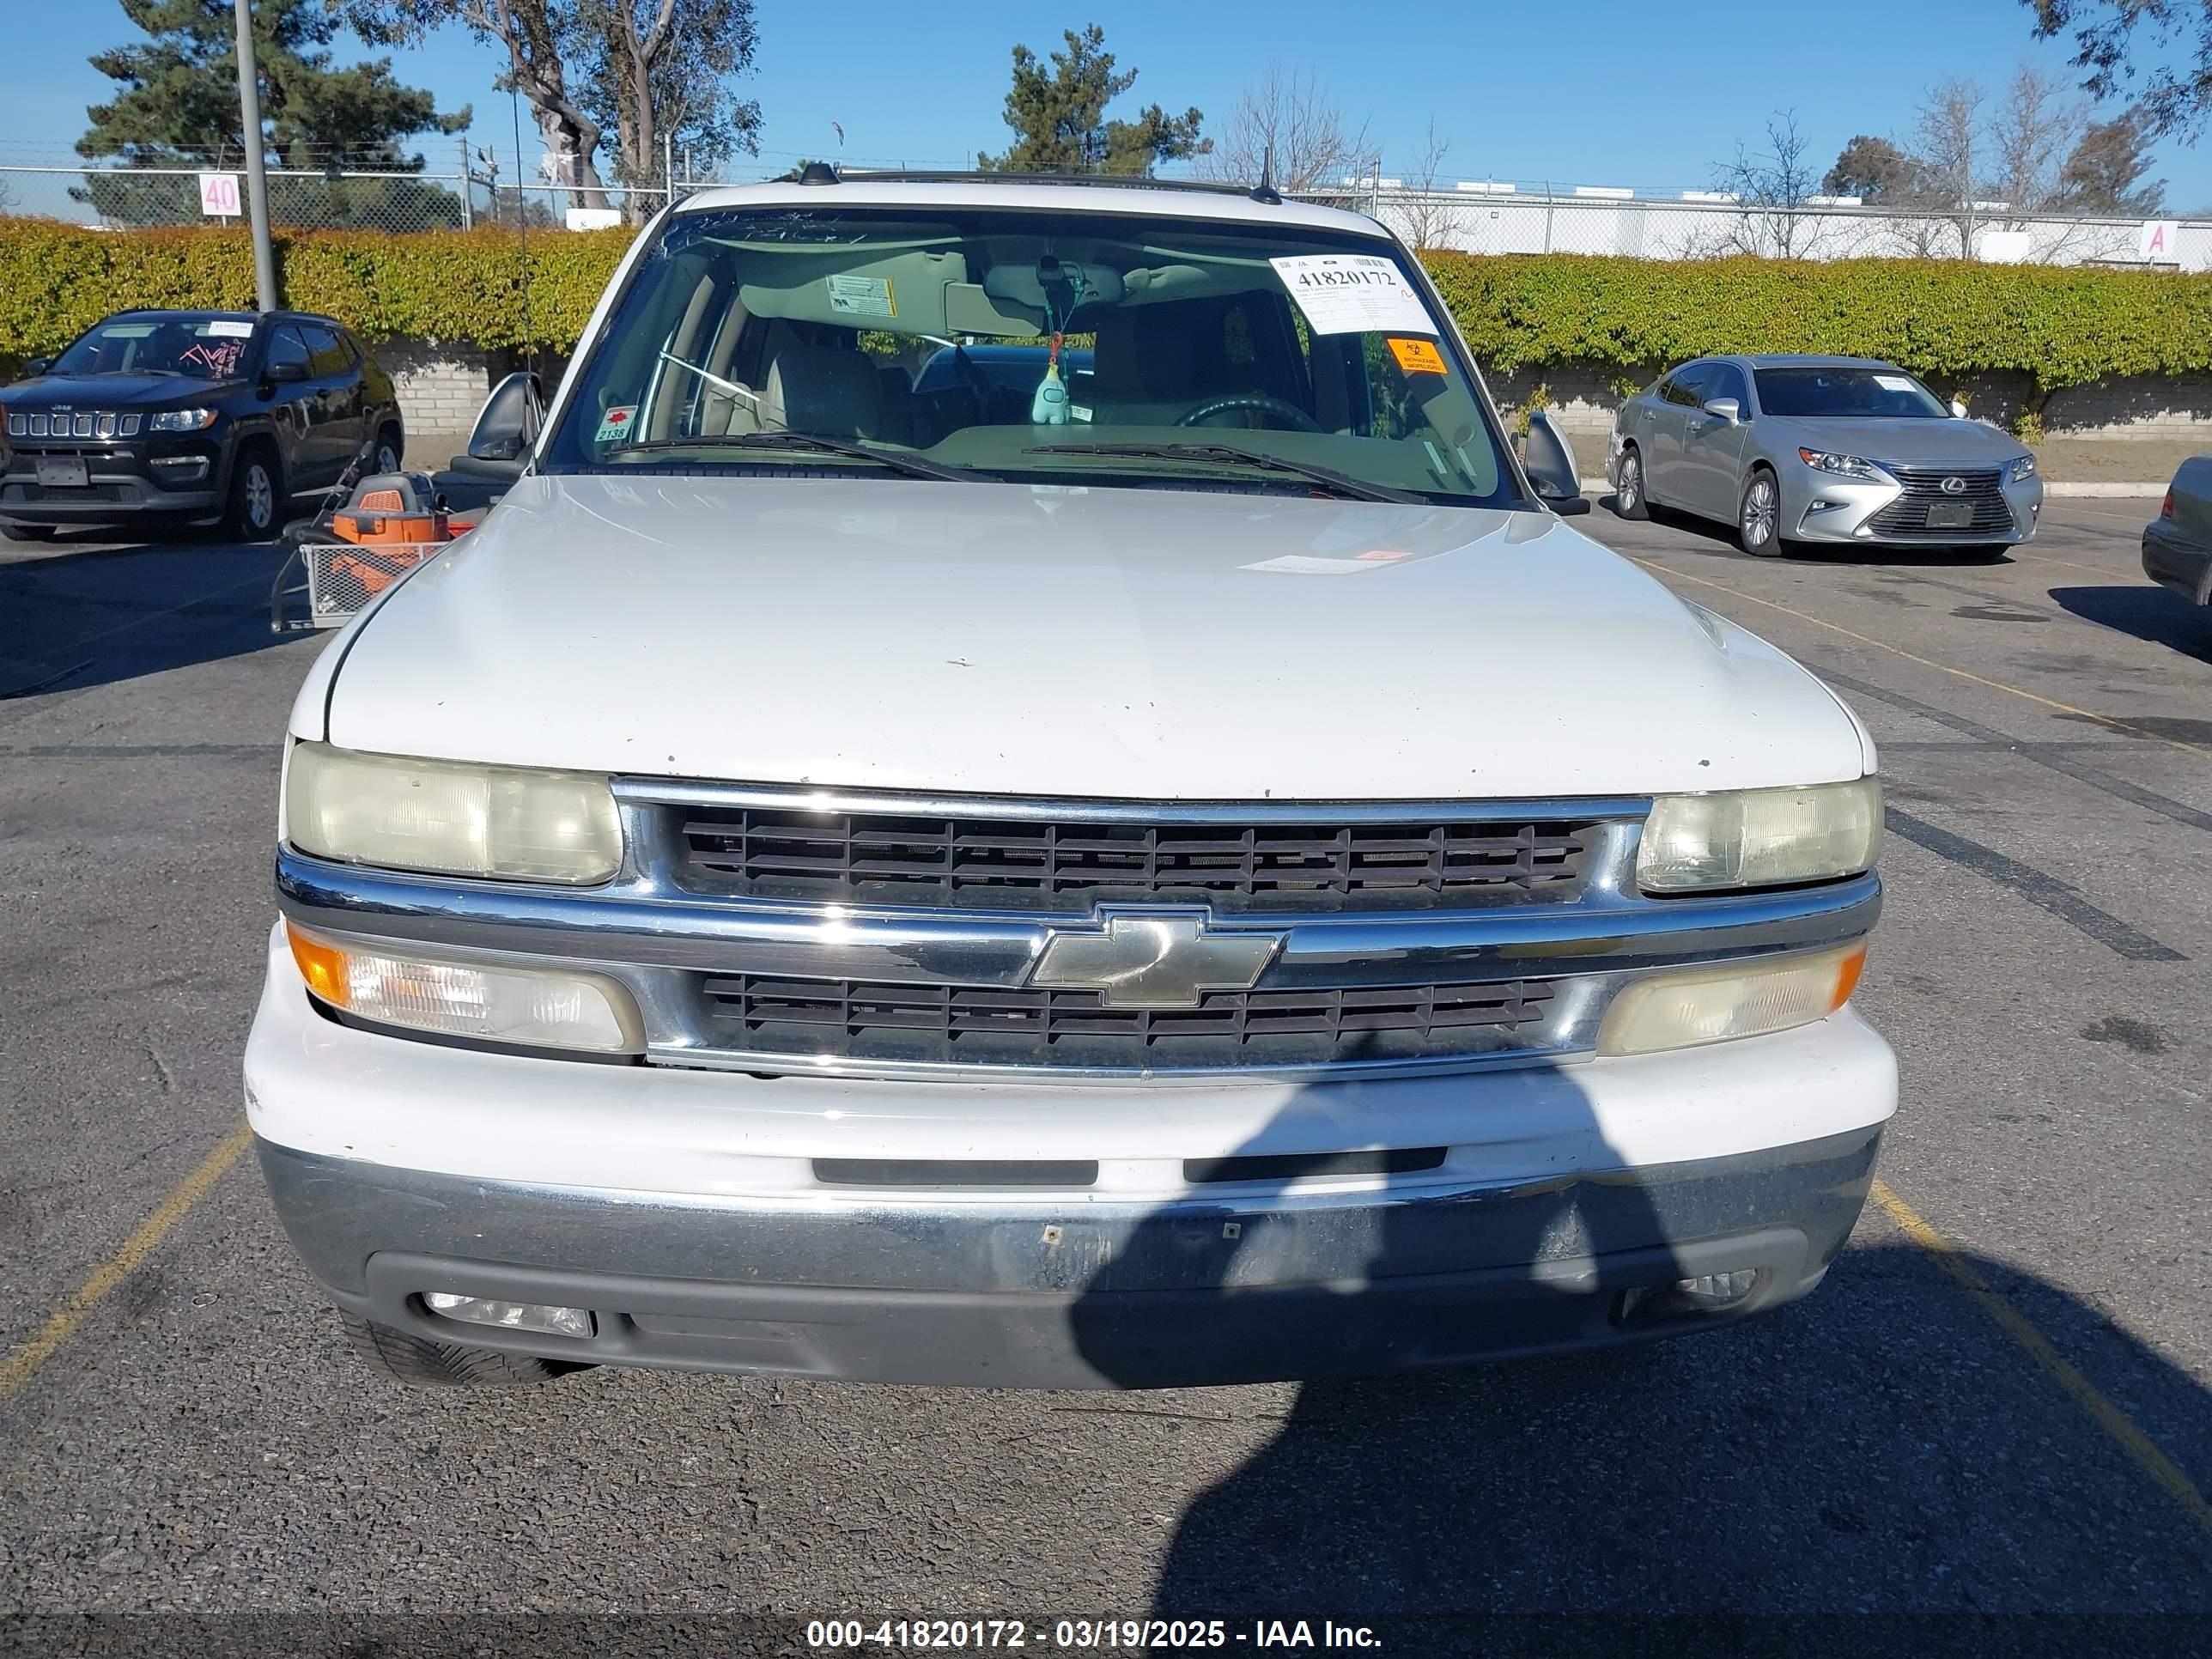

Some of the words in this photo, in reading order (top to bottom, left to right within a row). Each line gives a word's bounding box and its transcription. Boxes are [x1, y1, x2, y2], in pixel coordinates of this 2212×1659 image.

[206, 179, 236, 210] 40
[2148, 225, 2164, 252] A
[1299, 270, 1397, 287] 41820172
[599, 428, 625, 440] 2138
